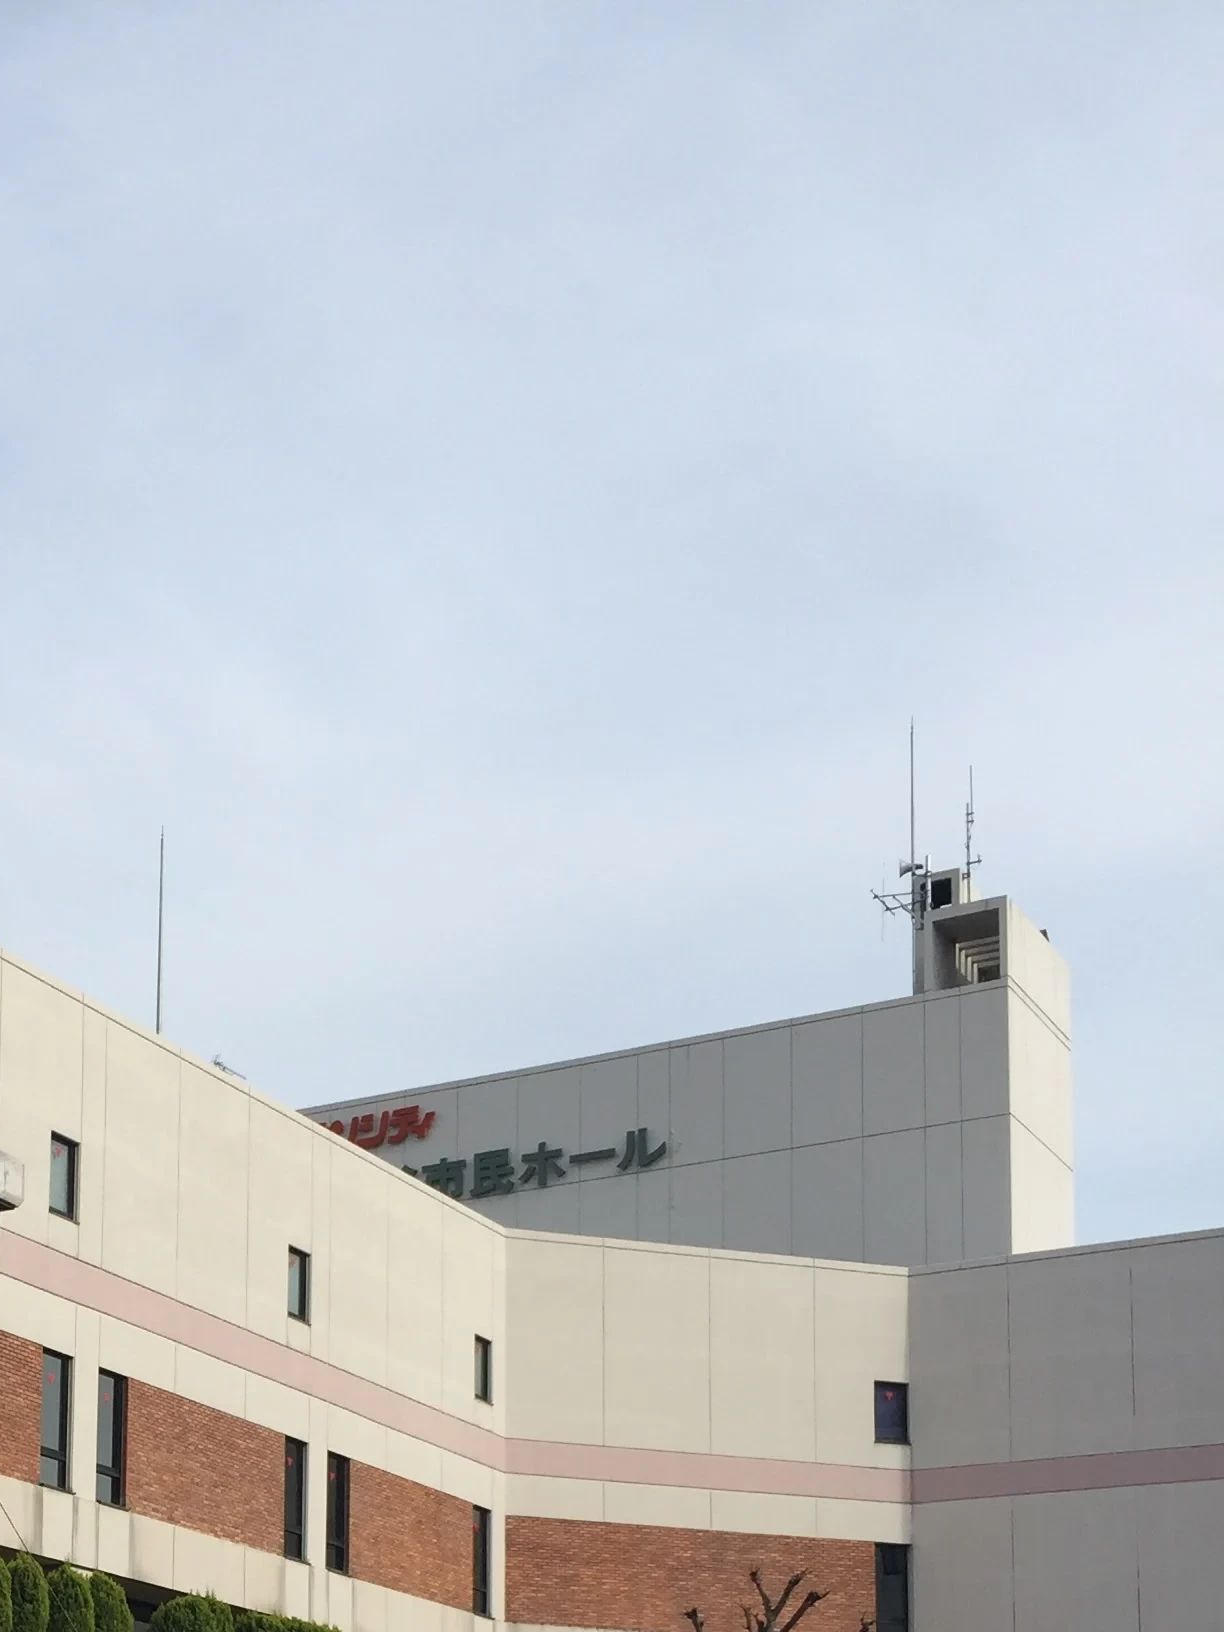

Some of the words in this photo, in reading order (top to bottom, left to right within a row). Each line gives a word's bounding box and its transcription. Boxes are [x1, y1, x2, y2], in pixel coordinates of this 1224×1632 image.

[402, 1127, 668, 1200] 市民ホール
